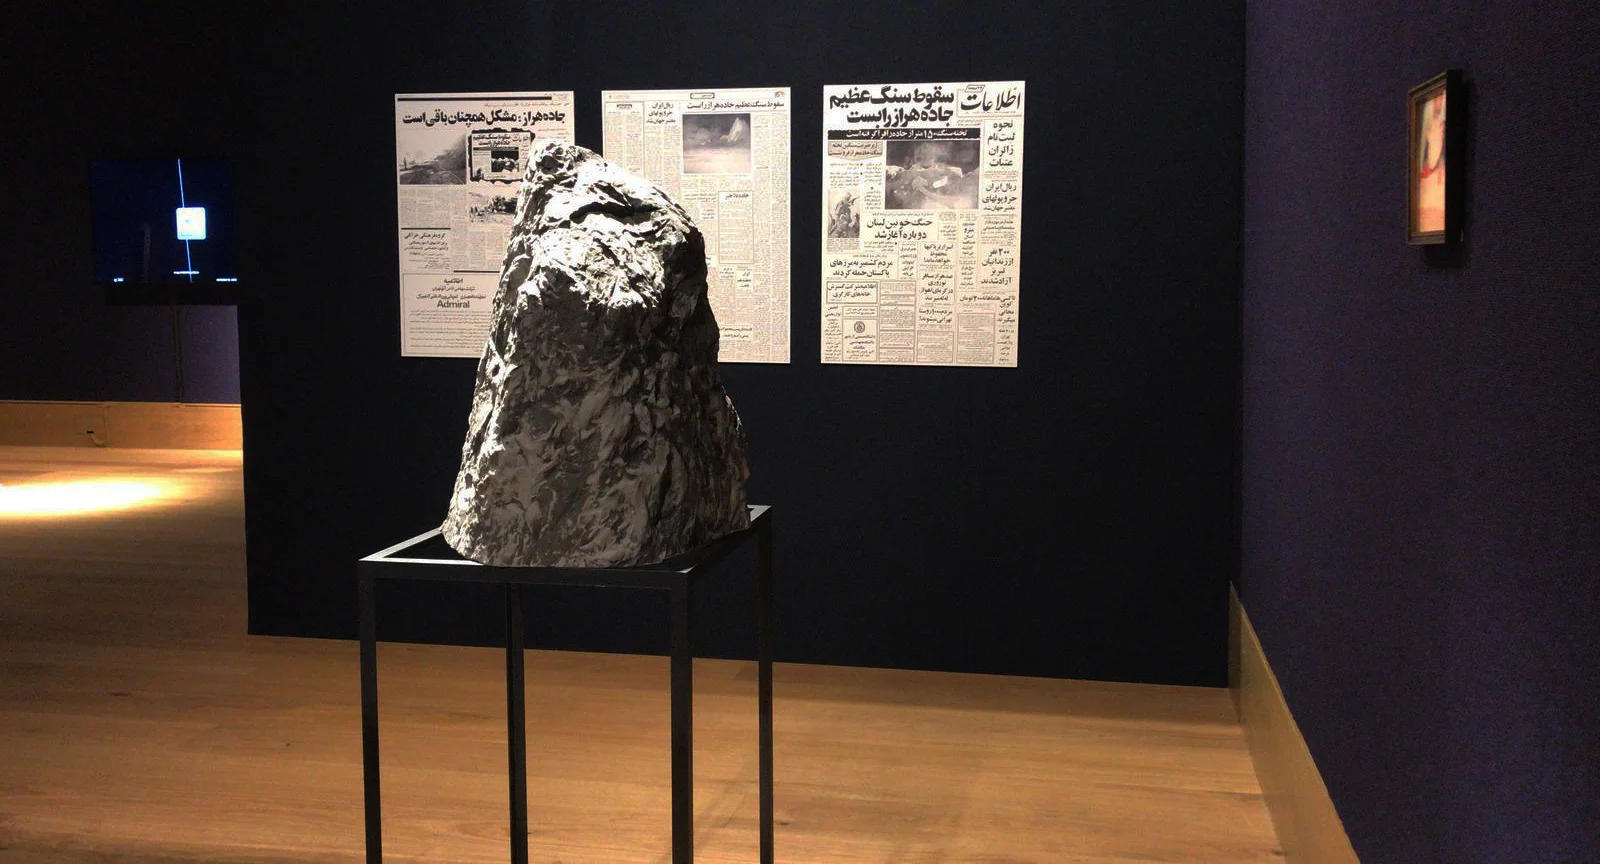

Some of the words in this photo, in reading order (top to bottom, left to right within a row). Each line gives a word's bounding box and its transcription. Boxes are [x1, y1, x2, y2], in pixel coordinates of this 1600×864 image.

[829, 86, 871, 110] عظیم
[871, 85, 911, 105] سنگ
[911, 85, 954, 110] سقوط
[960, 87, 1021, 112] اطلاعات
[402, 111, 426, 124] است
[426, 108, 448, 127] باقی
[450, 110, 486, 128] همچنان
[486, 109, 517, 126] مشکل
[543, 110, 566, 124] جاده
[846, 107, 882, 129] بست
[882, 107, 892, 128] را
[891, 106, 921, 128] هراز
[920, 106, 954, 127] جاده
[993, 120, 1014, 132] نحوه
[987, 132, 998, 145] نام
[985, 182, 1003, 193] ایران
[866, 217, 886, 228] لبنان
[885, 219, 912, 230] خونین
[911, 218, 933, 227] جنگ
[874, 230, 887, 239] شد
[887, 230, 903, 240] آغاز
[902, 230, 928, 240] دوباره
[437, 300, 470, 309] Admiral
